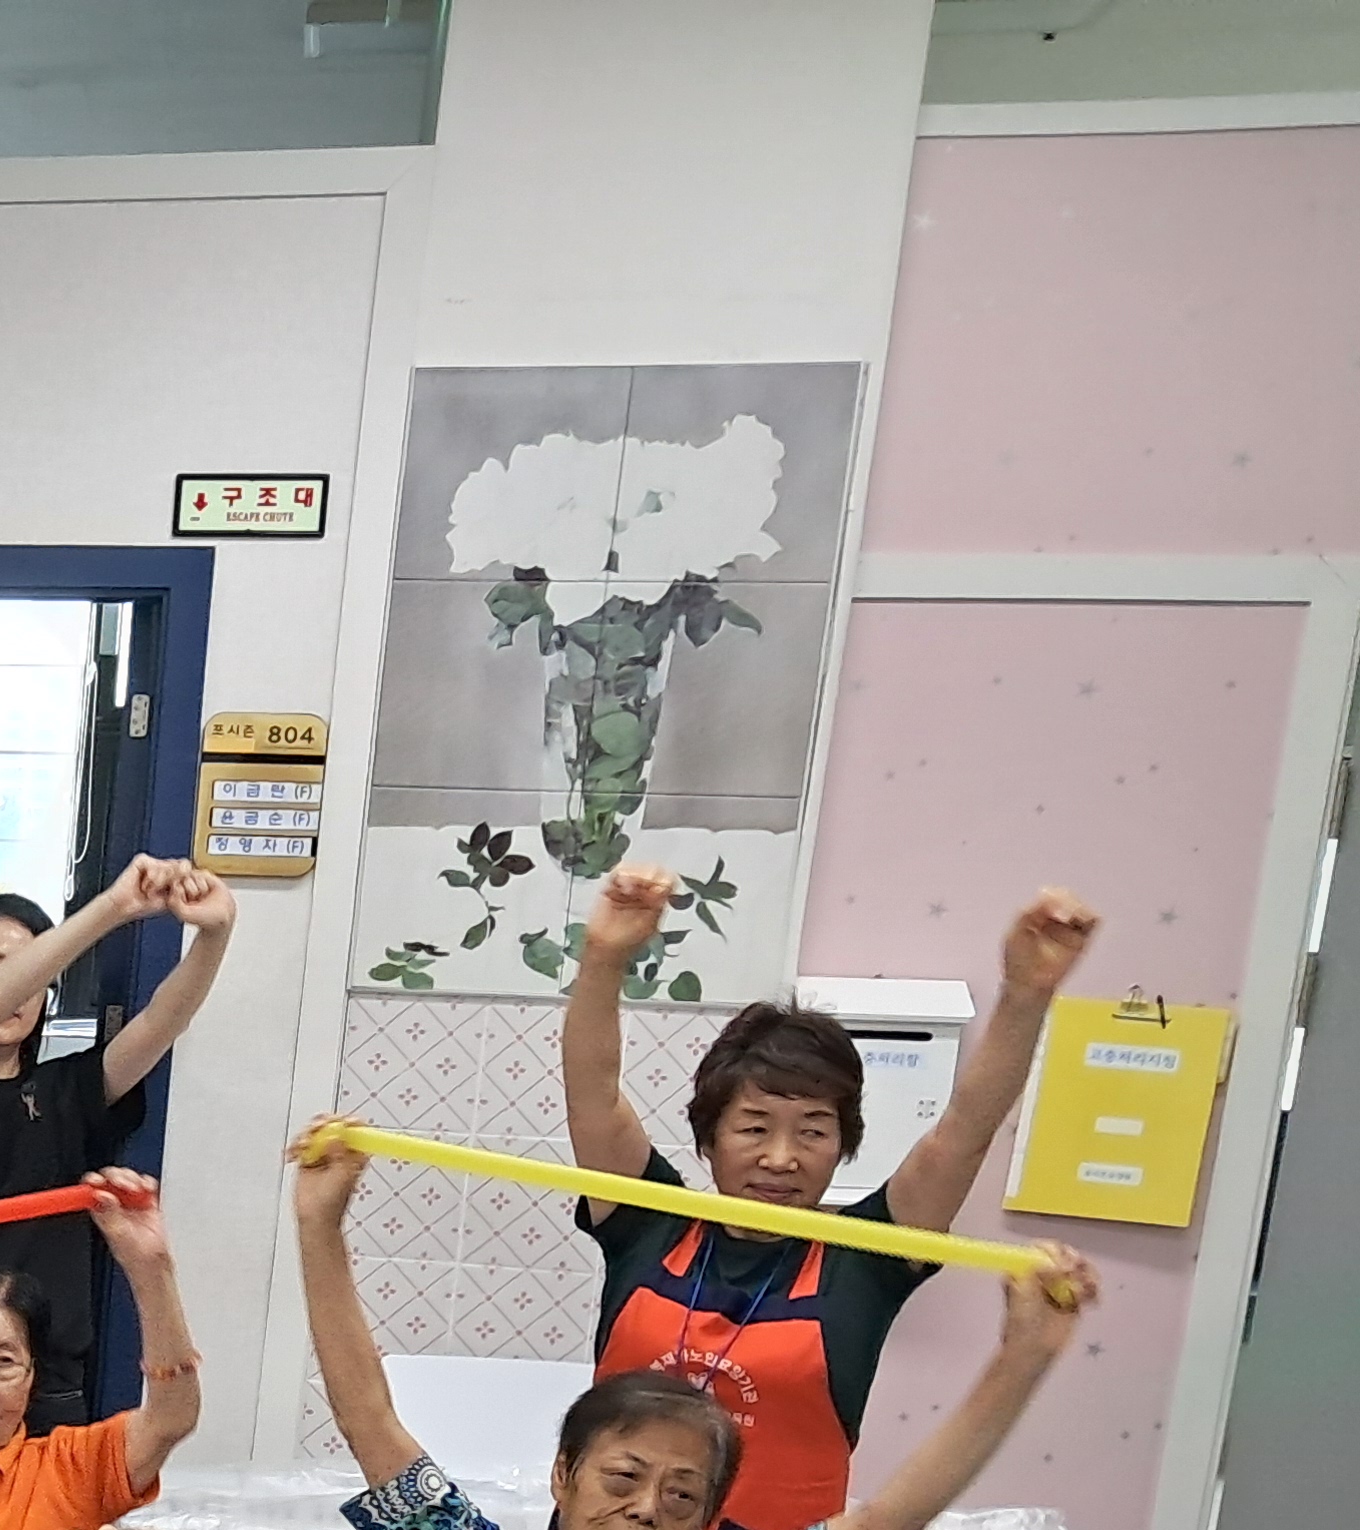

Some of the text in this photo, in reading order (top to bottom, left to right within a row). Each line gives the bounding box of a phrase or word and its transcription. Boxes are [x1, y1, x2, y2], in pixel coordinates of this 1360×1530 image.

[226, 511, 294, 522] ESCAPE CHUTE
[211, 723, 315, 745] 포시즌 804
